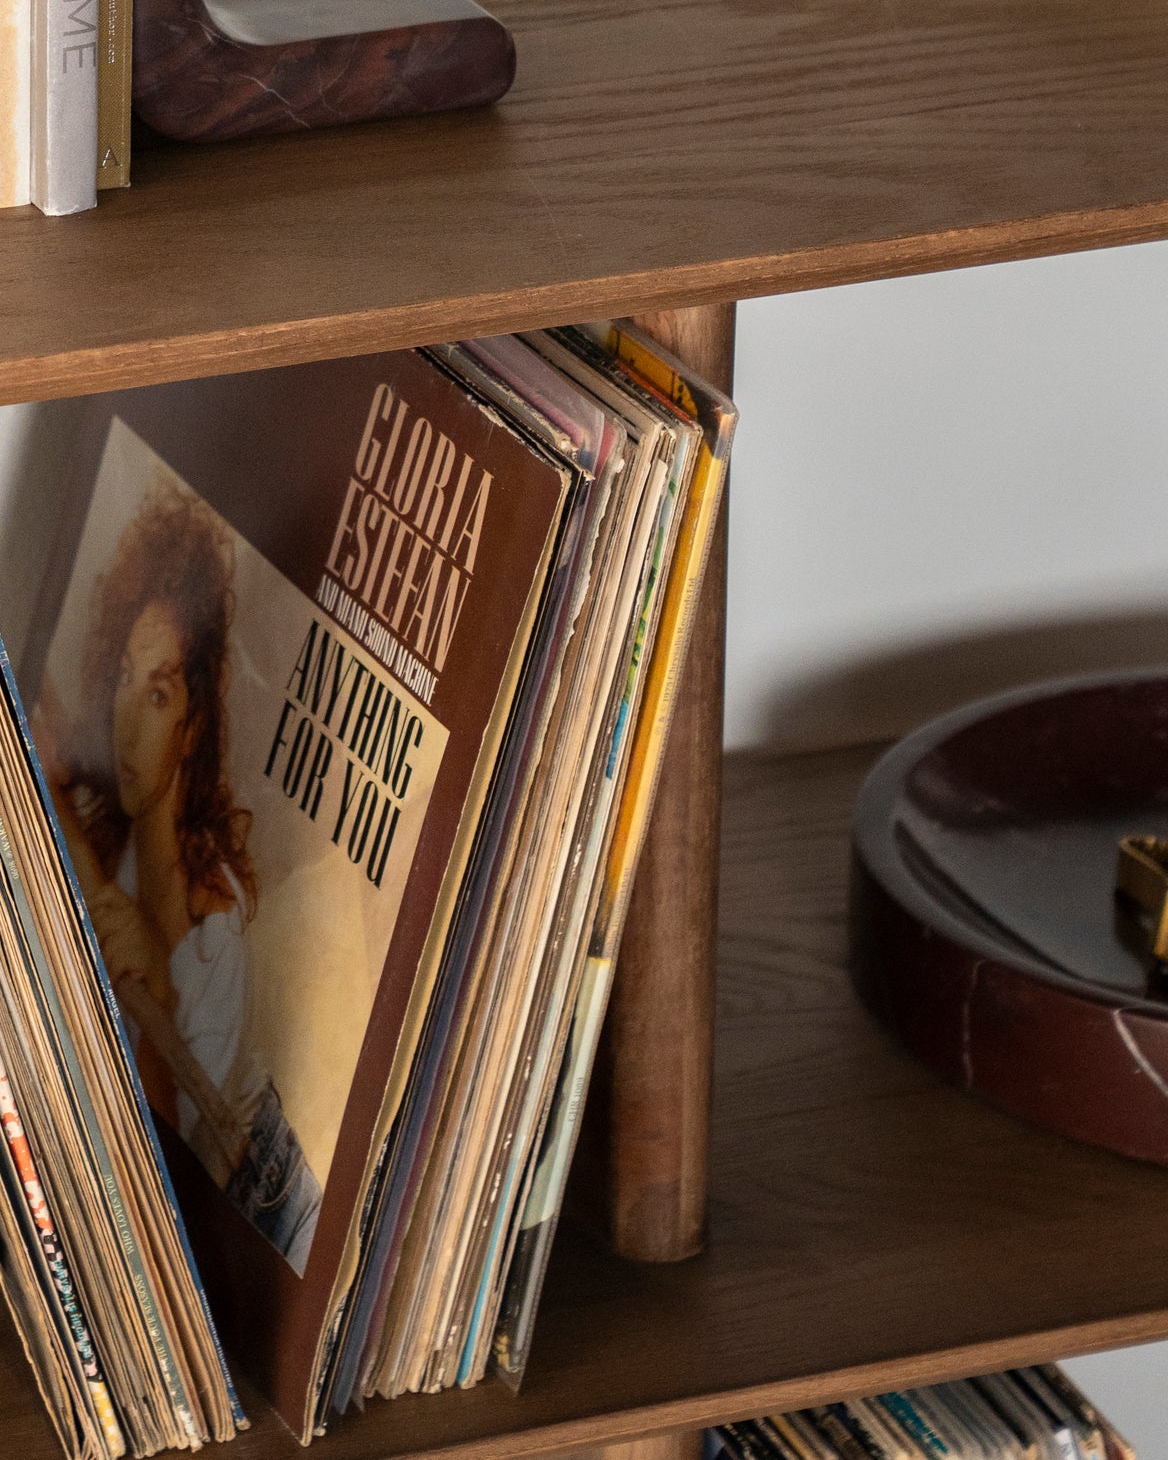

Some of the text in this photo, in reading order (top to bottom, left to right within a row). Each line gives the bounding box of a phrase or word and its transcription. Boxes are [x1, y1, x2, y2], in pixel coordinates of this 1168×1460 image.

[354, 383, 495, 575] GLORIA
[325, 476, 472, 673] ESTEFAN
[334, 590, 370, 641] MIAMI
[363, 617, 399, 669] SOUND
[392, 644, 439, 707] MACHINE
[286, 618, 425, 800] ANYTHING
[263, 697, 402, 890] FOR YOU
[107, 987, 121, 1019] ANGEL
[105, 1173, 115, 1194] YOU
[111, 1196, 127, 1228] LOVES
[121, 1229, 134, 1254] WHO
[53, 1258, 93, 1359] CHRYSALIS RECORDS
